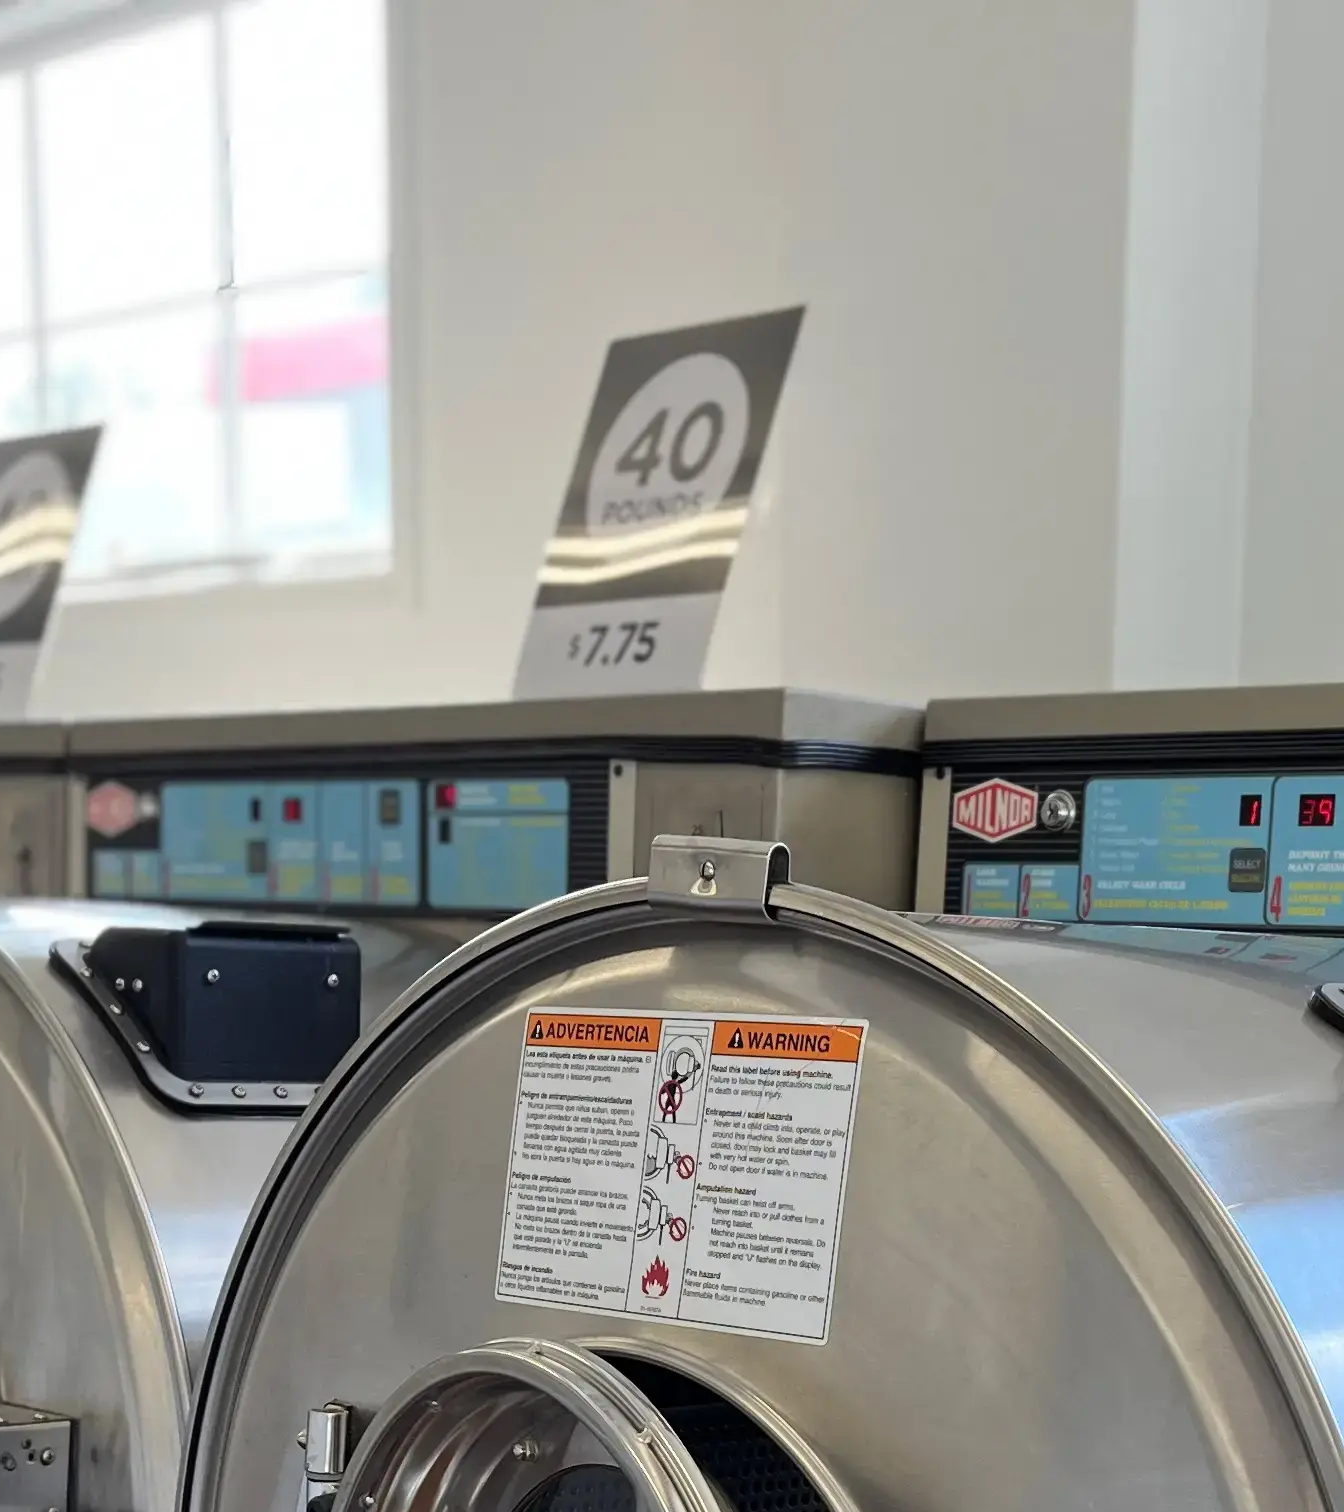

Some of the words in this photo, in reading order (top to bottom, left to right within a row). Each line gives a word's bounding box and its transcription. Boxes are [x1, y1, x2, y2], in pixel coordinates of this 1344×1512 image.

[615, 401, 724, 487] 40
[568, 621, 660, 667] $7.75
[958, 788, 1031, 832] MILNOR
[1302, 799, 1333, 825] 39
[1233, 859, 1261, 869] SELECT
[1022, 873, 1031, 917] 2
[1083, 874, 1092, 919] 3
[1270, 876, 1282, 922] 4
[546, 1022, 649, 1044] ADVERTENCIA
[748, 1031, 830, 1053] WARNING
[711, 1064, 727, 1073] Read
[729, 1065, 740, 1073] this
[742, 1066, 758, 1075] label
[760, 1067, 780, 1076] before
[783, 1069, 800, 1079] using
[803, 1070, 833, 1079] machine.
[710, 1076, 729, 1084] Failure
[739, 1077, 756, 1085] follow
[758, 1078, 774, 1086] these
[776, 1080, 812, 1090] precautions
[814, 1082, 831, 1090] could
[833, 1083, 851, 1091] result
[741, 1089, 762, 1097] serious
[709, 1162, 717, 1170] Do
[730, 1165, 744, 1173] open
[746, 1165, 761, 1174] door
[767, 1167, 784, 1176] water
[696, 1183, 733, 1194] Amputation
[734, 1186, 756, 1196] hazard
[686, 1268, 698, 1277] Fire
[699, 1269, 721, 1279] hazard
